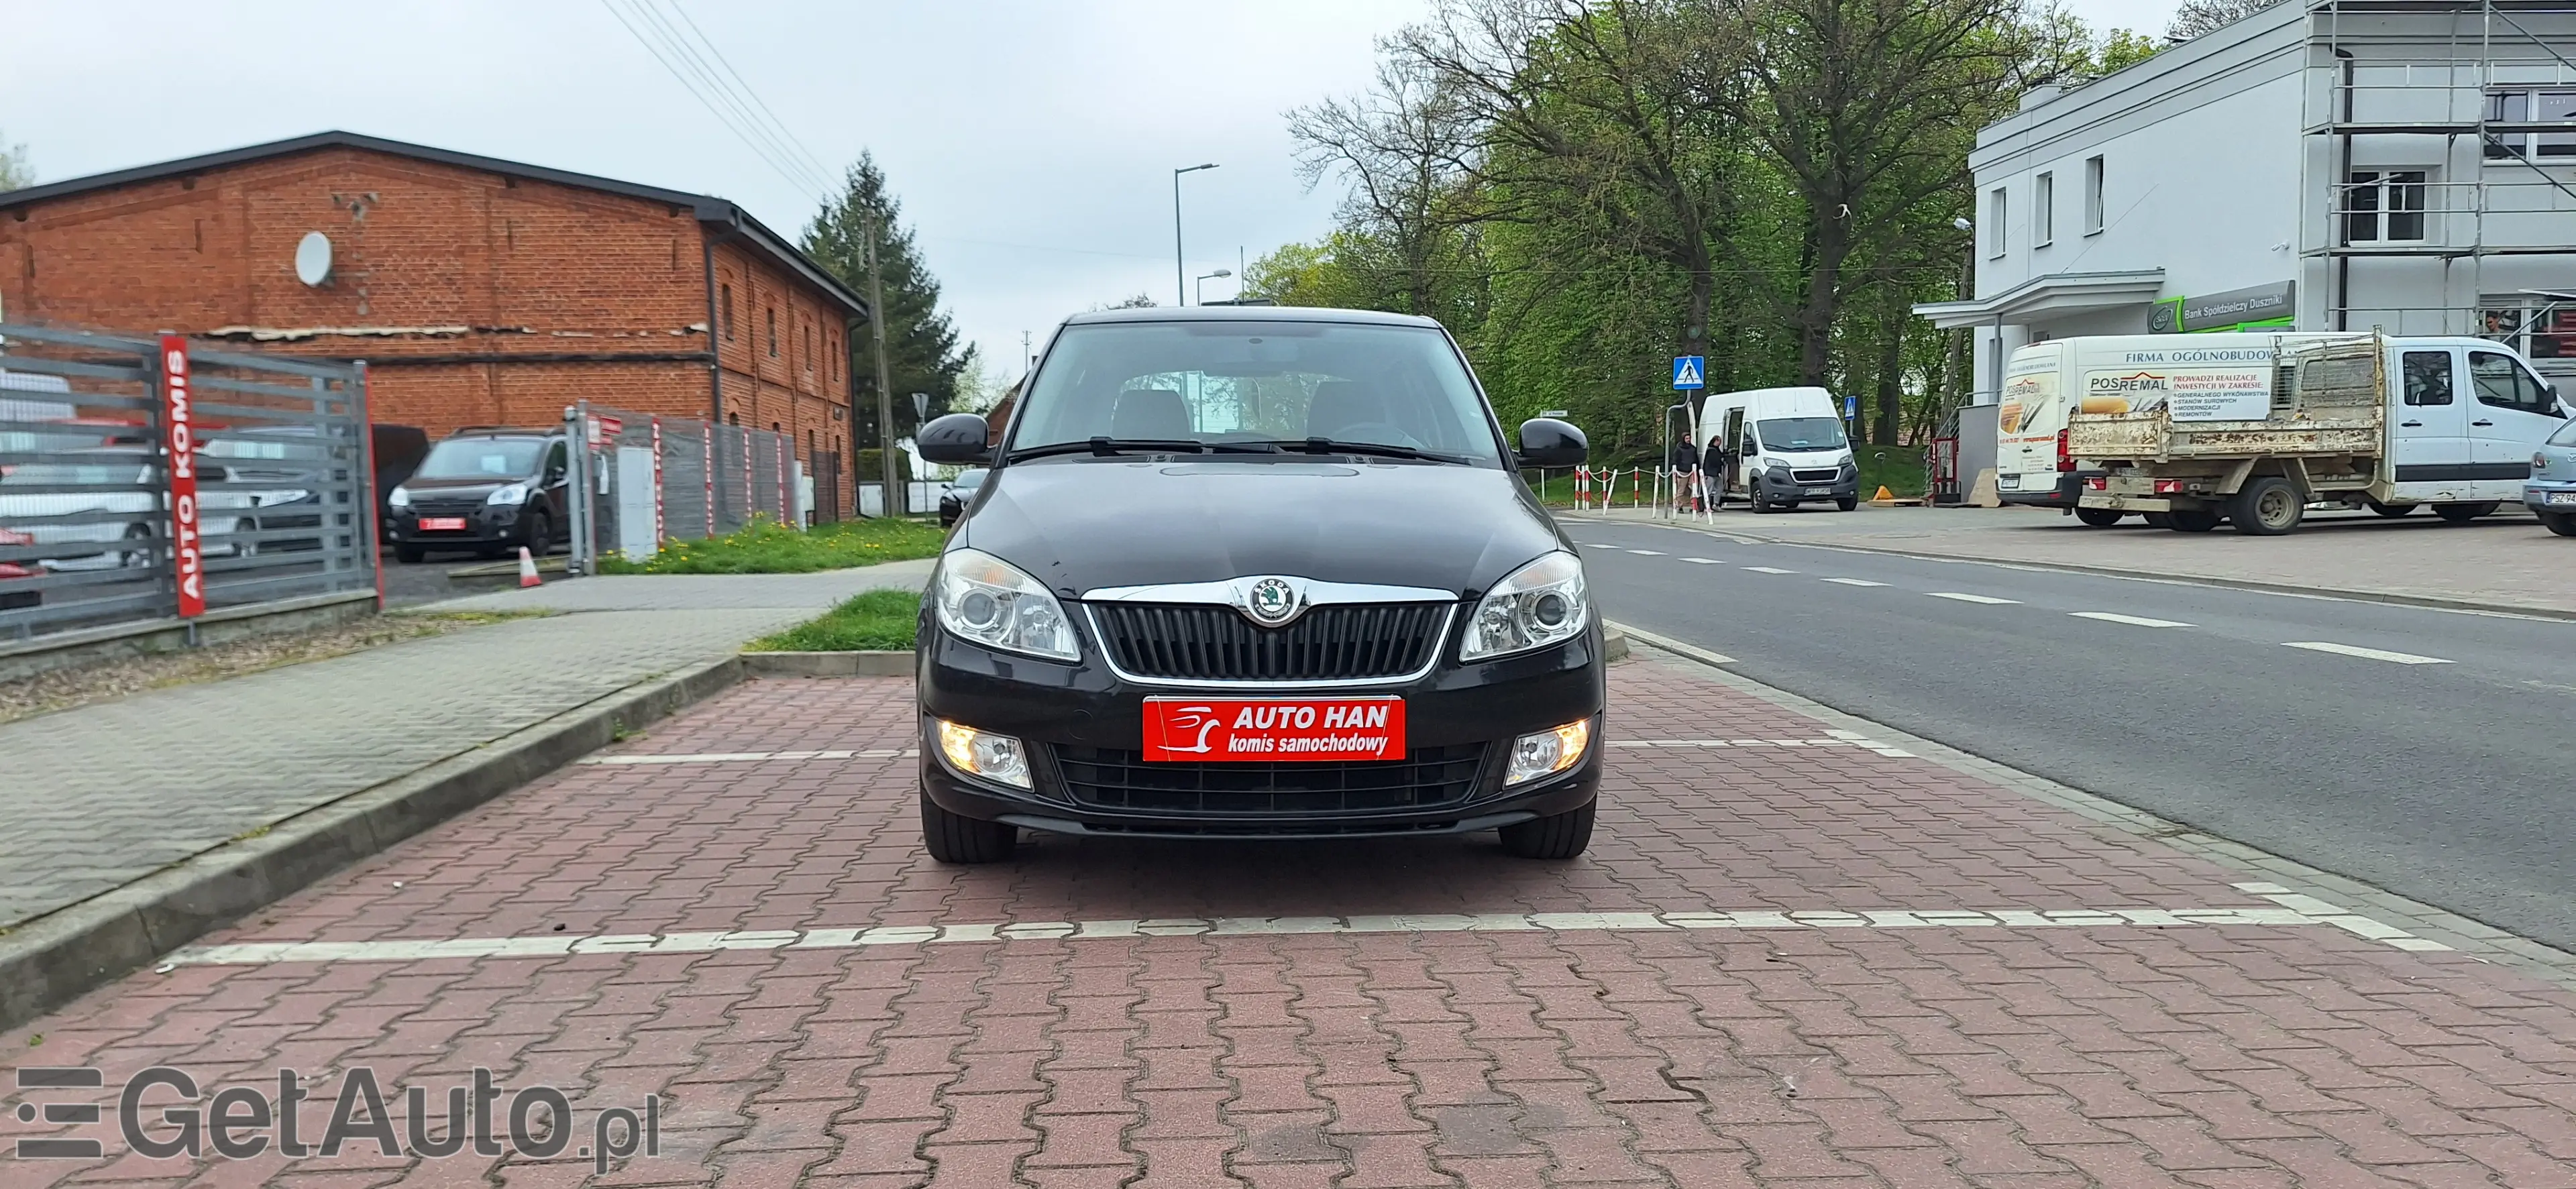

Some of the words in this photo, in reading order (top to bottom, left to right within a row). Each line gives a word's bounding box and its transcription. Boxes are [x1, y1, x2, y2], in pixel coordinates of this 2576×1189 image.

[2184, 308, 2202, 319] Bank
[2249, 294, 2283, 309] Duszniki
[2126, 352, 2164, 363] FIRMA
[2090, 377, 2168, 391] POSREMAL
[2174, 382, 2216, 390] INWESTYCJI
[2216, 374, 2257, 382] REALIZACJE
[167, 349, 192, 478] KOMIS
[2551, 494, 2565, 503] PSZ
[177, 494, 200, 600] AUTO
[1232, 705, 1316, 729] AUTO
[1323, 705, 1388, 728] HAN
[1228, 733, 1274, 752] komis
[1278, 732, 1389, 756] samochodowy
